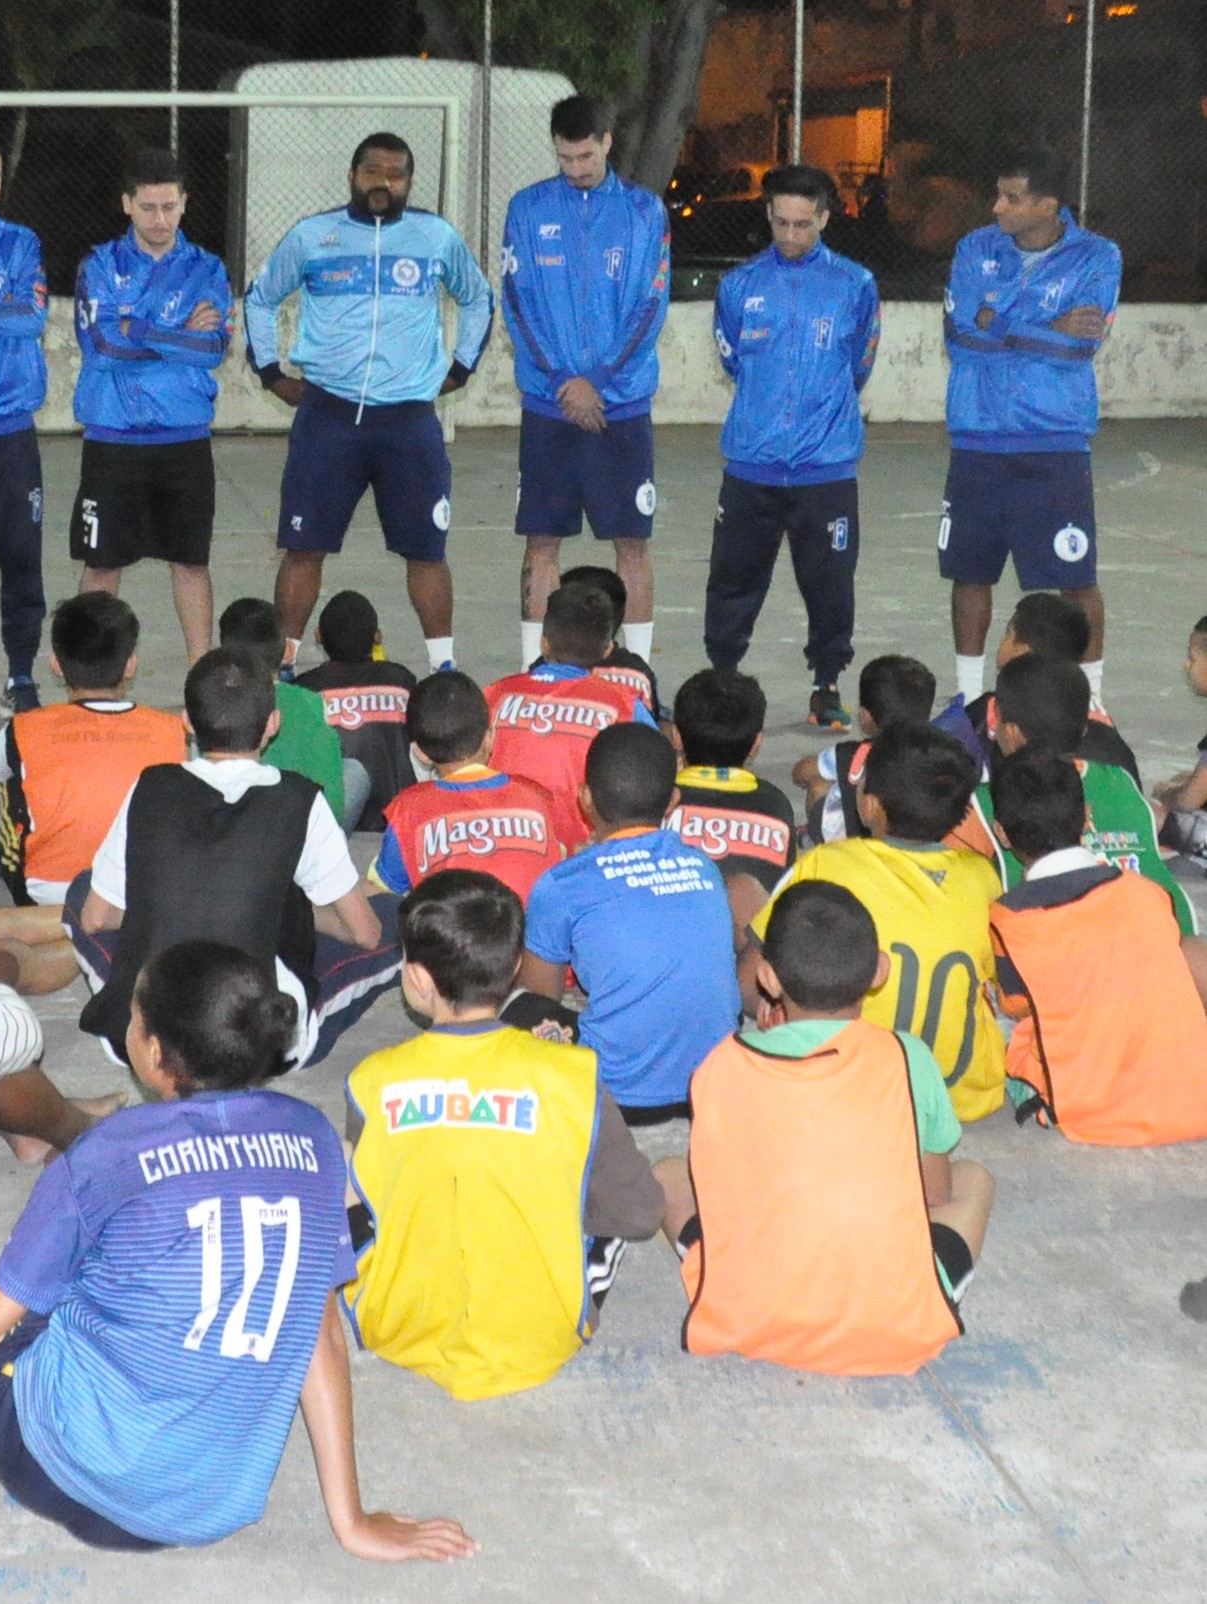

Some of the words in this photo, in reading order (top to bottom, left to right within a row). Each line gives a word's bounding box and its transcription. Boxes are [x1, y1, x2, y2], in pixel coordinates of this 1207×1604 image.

[327, 693, 408, 726] agnus
[494, 693, 610, 734] Magnus
[418, 816, 545, 873] Magnus
[659, 807, 785, 855] Magnus
[596, 849, 651, 867] Projeto
[603, 862, 657, 880] Escola
[890, 941, 980, 1089] 10
[385, 1095, 534, 1131] TAUBATÉ
[138, 1132, 319, 1185] CORINTHIANS
[183, 1195, 301, 1362] 10
